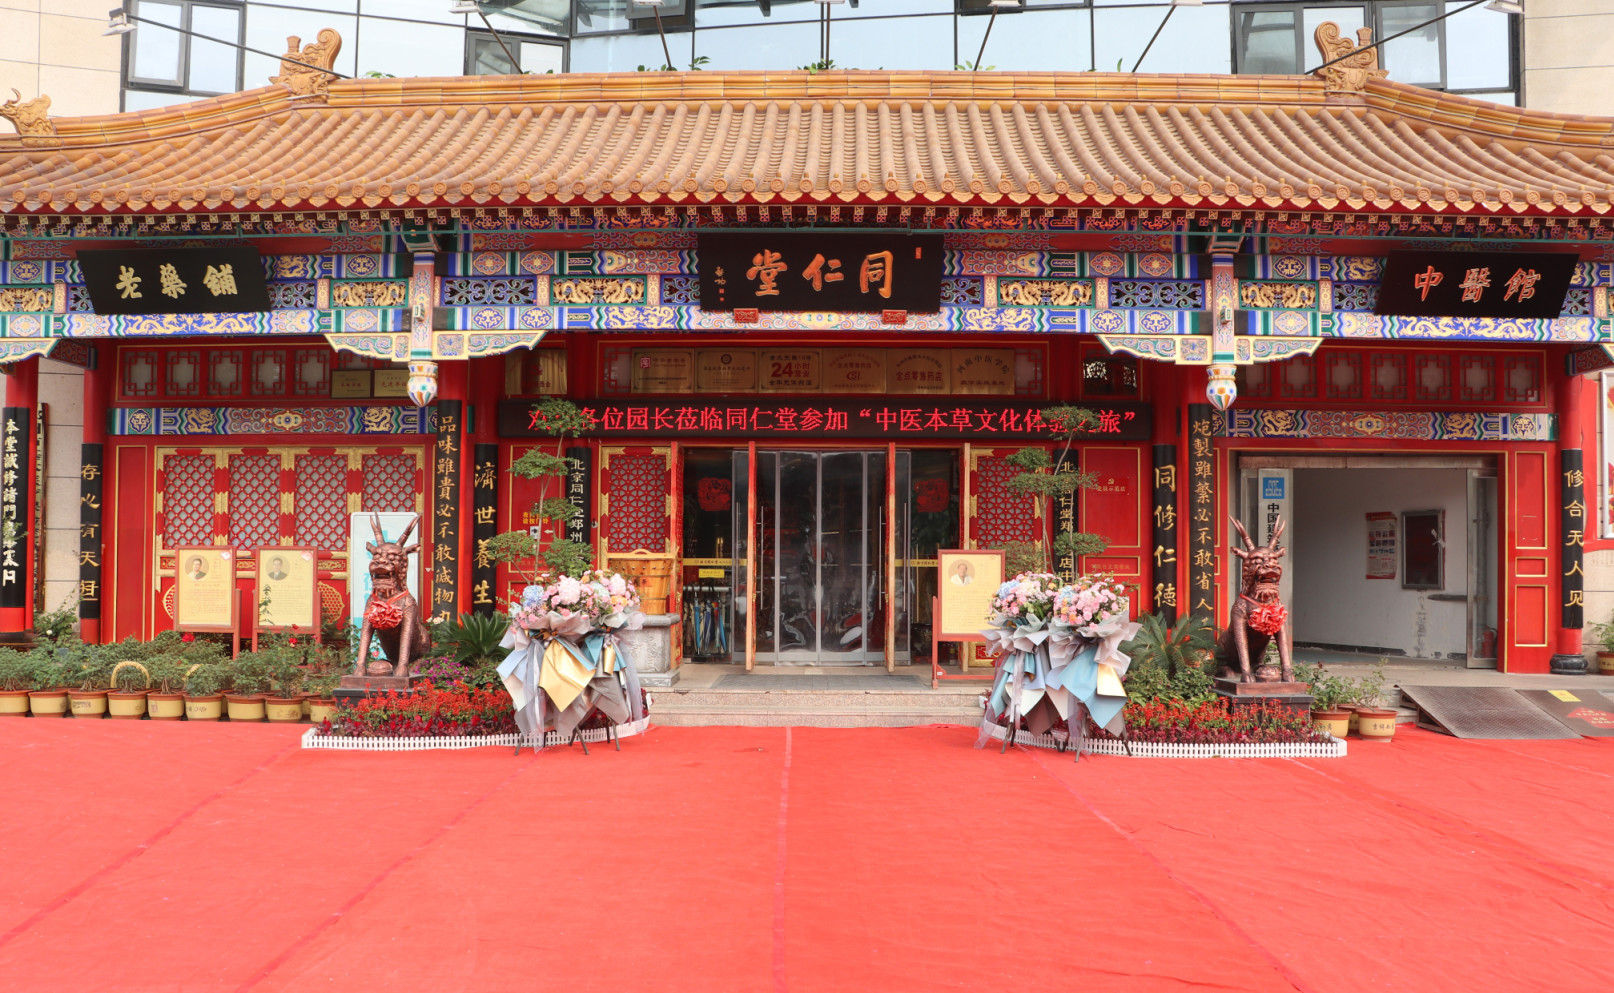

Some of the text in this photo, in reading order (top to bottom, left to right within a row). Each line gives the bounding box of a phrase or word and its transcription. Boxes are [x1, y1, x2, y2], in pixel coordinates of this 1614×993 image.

[746, 249, 894, 299] 同仁堂
[1414, 265, 1541, 302] 中醫館
[771, 362, 793, 378] 24
[1191, 419, 1214, 627] 炮製雖繁必不敢省人
